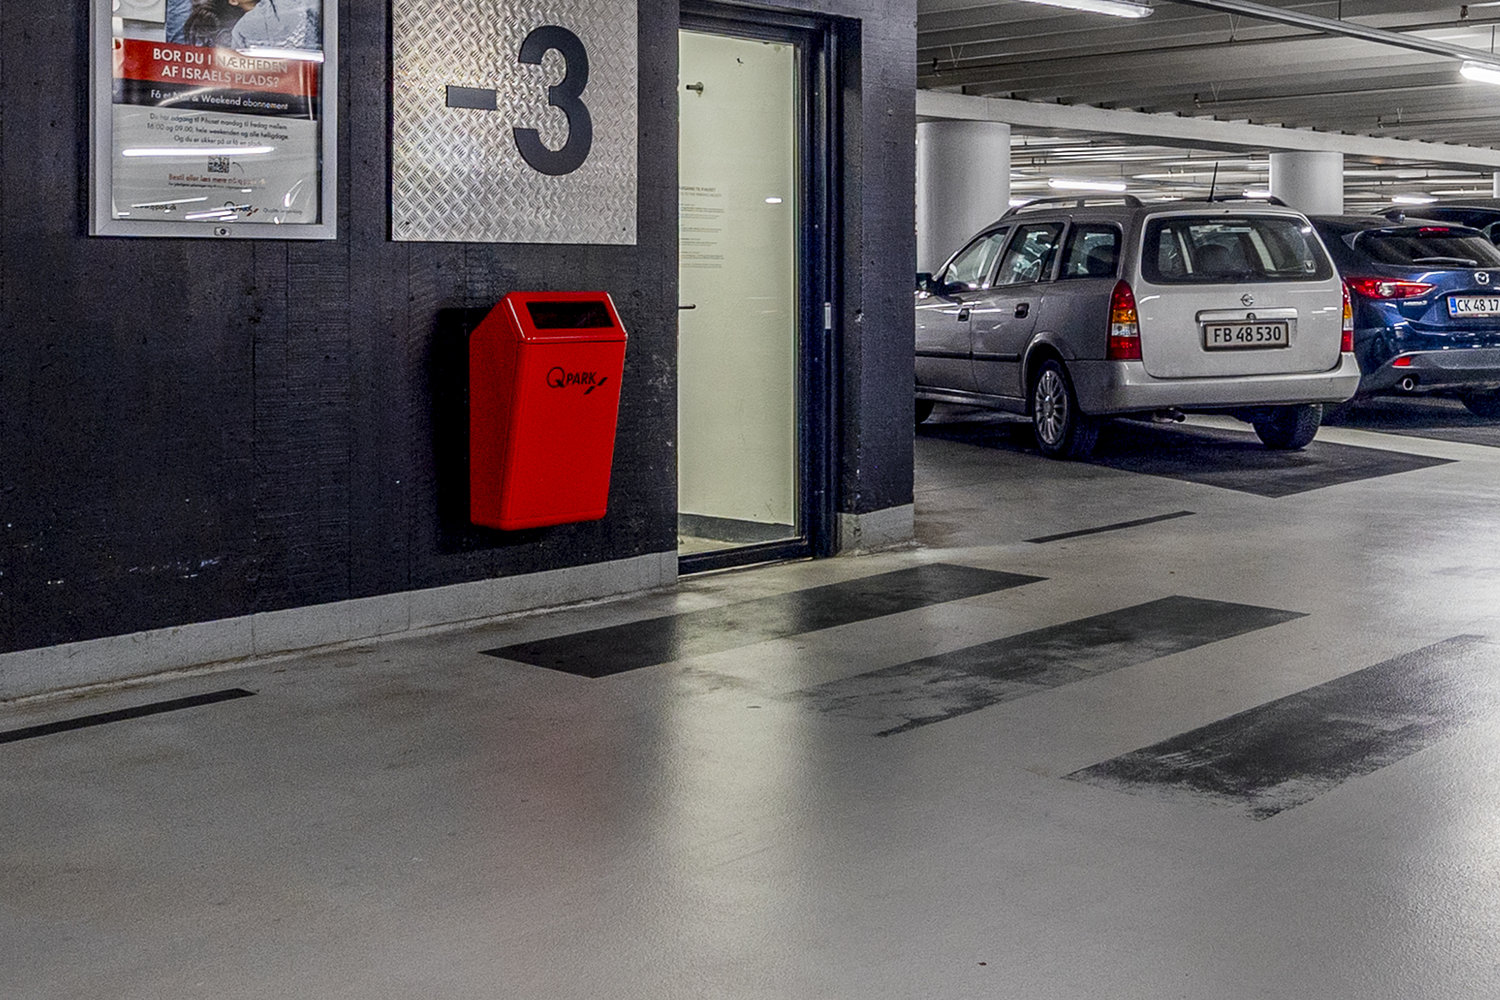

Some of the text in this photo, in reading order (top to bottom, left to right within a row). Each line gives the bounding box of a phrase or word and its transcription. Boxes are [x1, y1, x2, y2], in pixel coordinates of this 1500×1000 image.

[153, 47, 288, 74] BOR DU I NÆRHEDEN
[161, 64, 280, 89] AF ISRAELS PLADS?
[201, 94, 242, 106] Weekend
[242, 97, 289, 111] abonnement
[1457, 299, 1472, 312] CK
[1473, 299, 1486, 312] 48
[1214, 326, 1281, 343] FB 48 530
